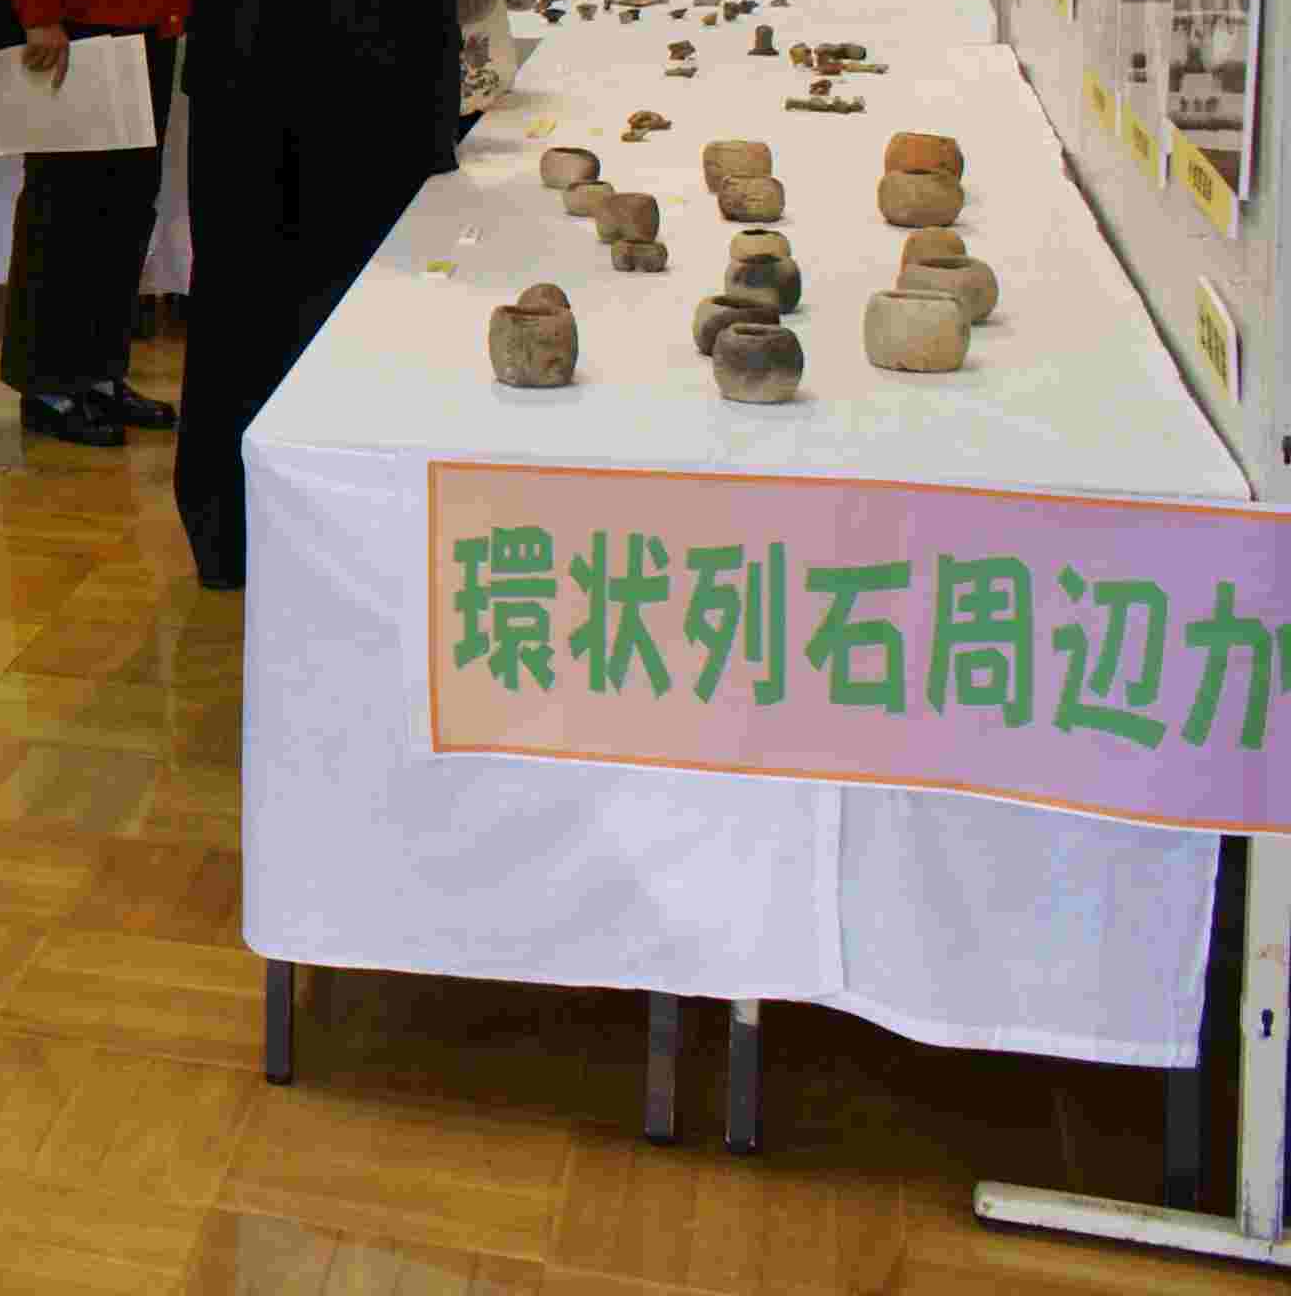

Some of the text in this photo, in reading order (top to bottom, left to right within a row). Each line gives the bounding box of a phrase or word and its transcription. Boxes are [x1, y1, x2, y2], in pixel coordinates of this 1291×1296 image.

[452, 526, 1291, 751] 環状列石周辺か
